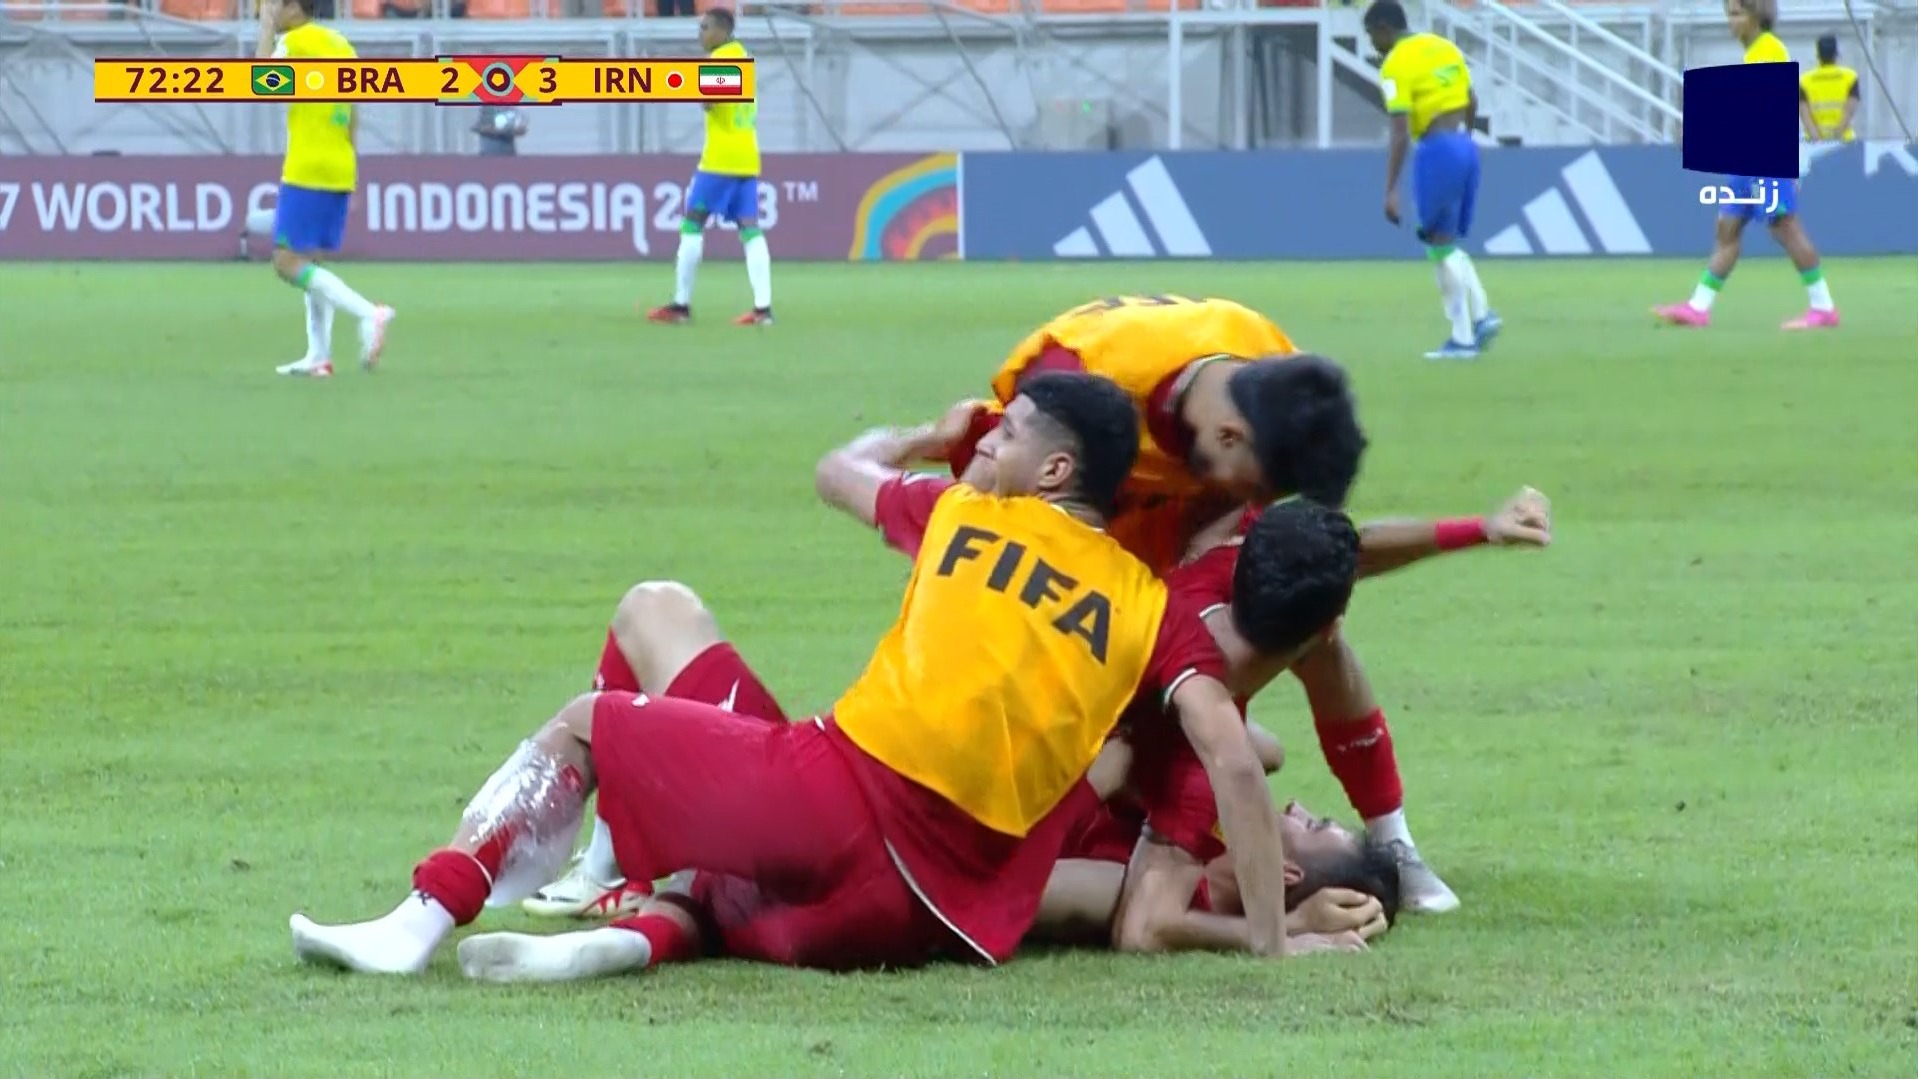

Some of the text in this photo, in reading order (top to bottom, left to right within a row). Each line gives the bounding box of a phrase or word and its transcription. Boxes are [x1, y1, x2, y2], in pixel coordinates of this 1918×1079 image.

[31, 182, 233, 231] WORLD
[366, 183, 649, 254] INDONESIA
[936, 525, 1111, 666] FIFA
